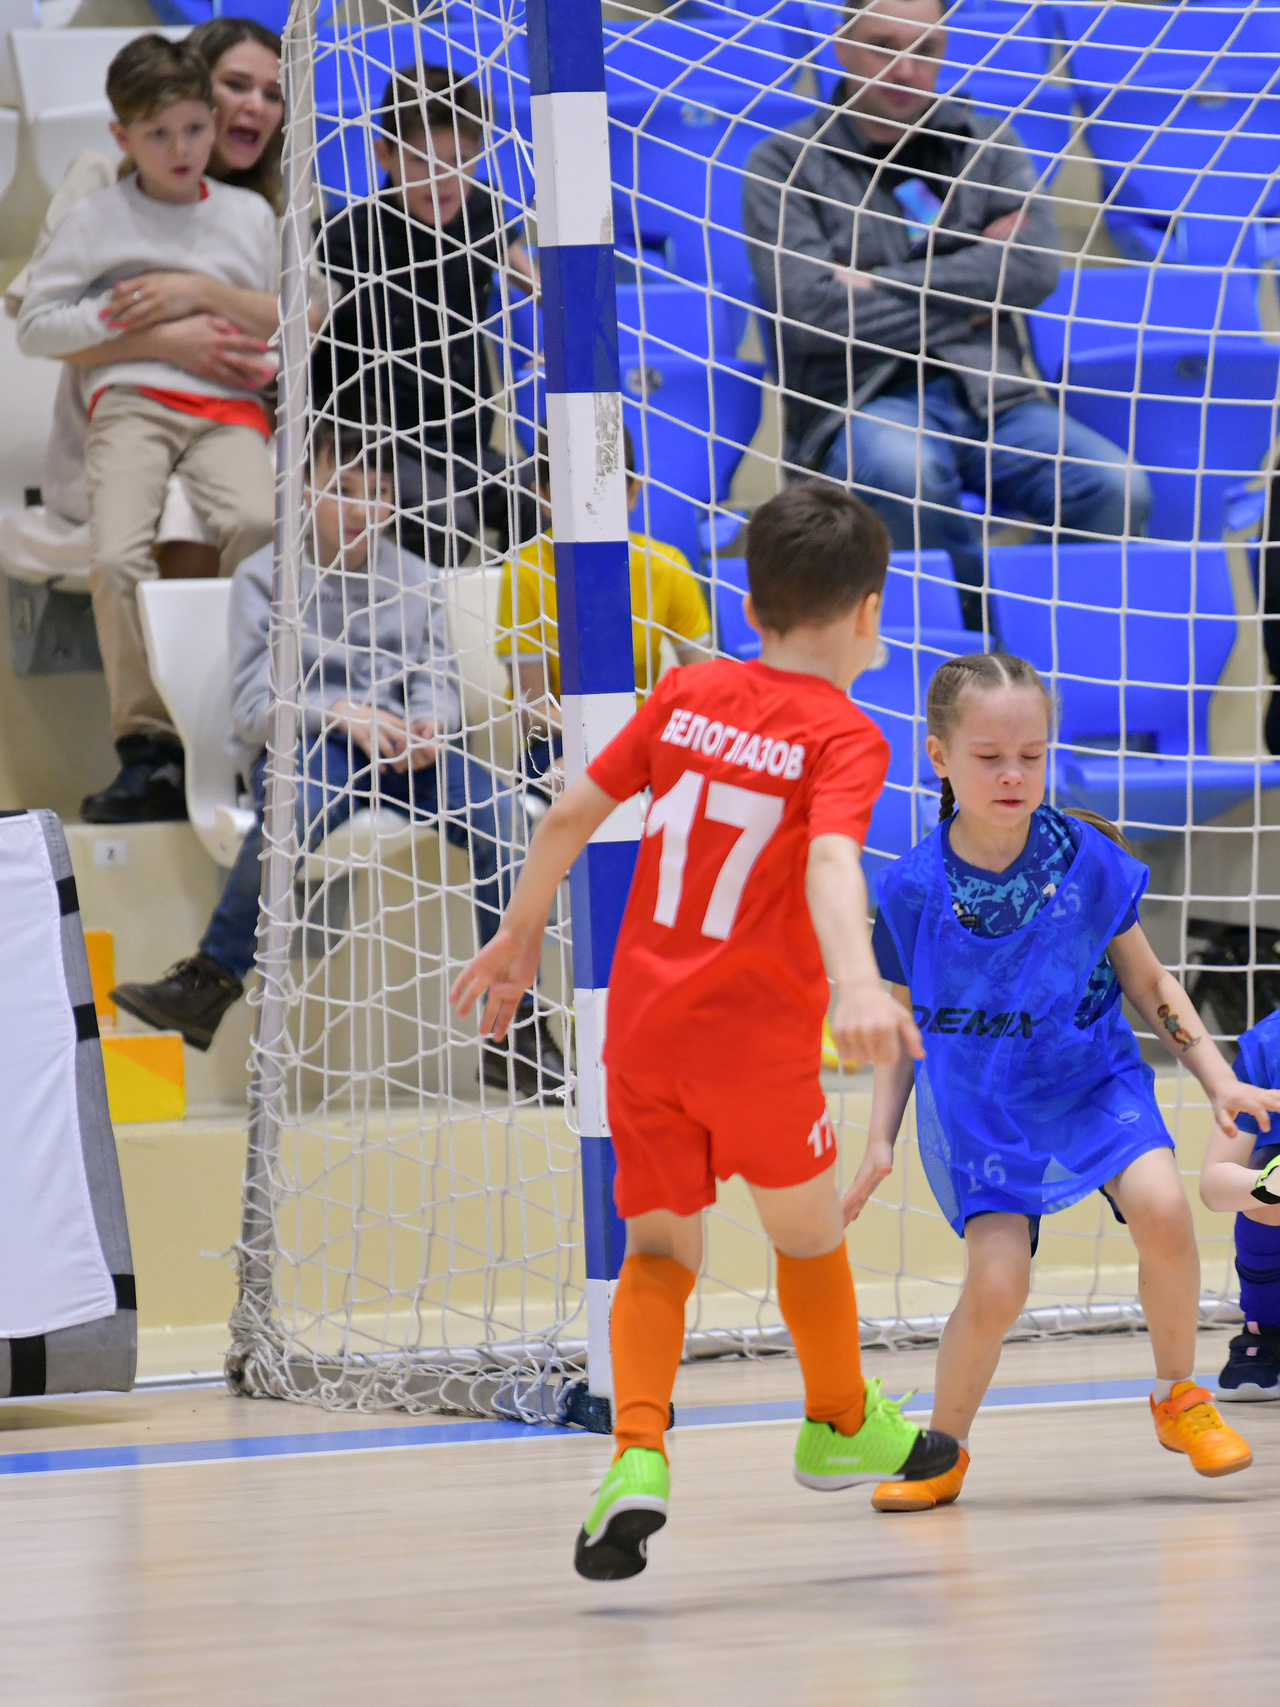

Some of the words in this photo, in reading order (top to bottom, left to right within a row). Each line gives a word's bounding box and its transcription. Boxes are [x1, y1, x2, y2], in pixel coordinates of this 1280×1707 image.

[659, 707, 805, 780] БЕЛОГЛАЗОВ
[645, 769, 786, 941] 17
[967, 1153, 1006, 1195] 16
